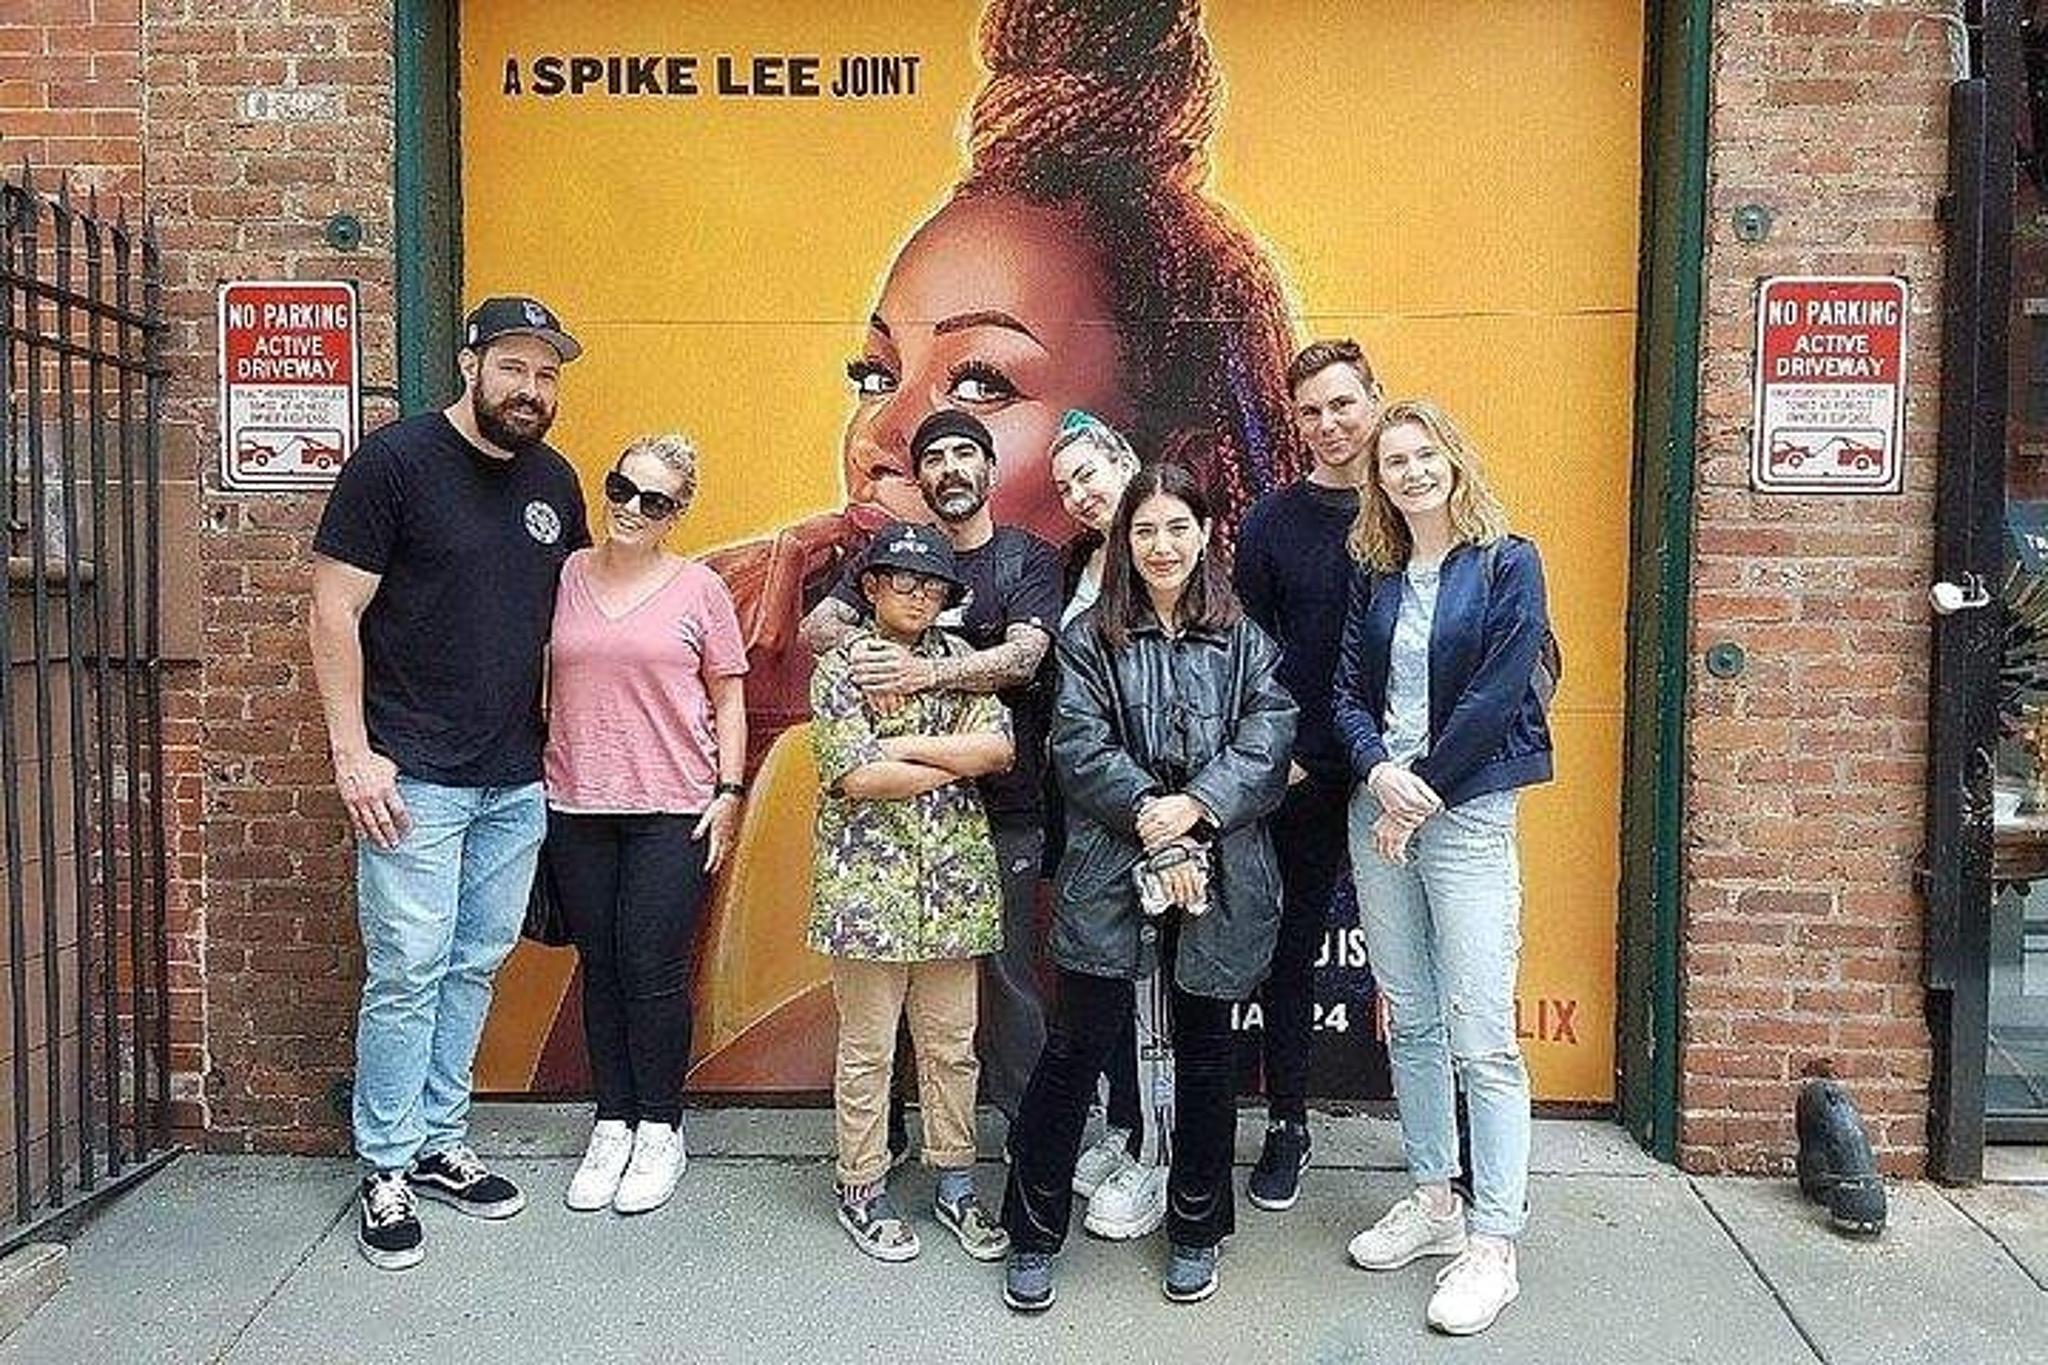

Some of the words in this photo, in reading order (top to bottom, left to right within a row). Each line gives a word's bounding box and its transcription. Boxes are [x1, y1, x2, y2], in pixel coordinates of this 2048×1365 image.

[503, 58, 521, 95] A
[532, 57, 698, 96] SPIKE
[716, 57, 820, 96] LEE
[832, 57, 920, 97] JOINT
[229, 303, 255, 328] NO
[263, 303, 348, 329] PARKING
[1768, 300, 1798, 326] NO
[1807, 300, 1898, 326] PARKING
[254, 335, 324, 356] ACTIVE
[1793, 334, 1870, 354] ACTIVE
[237, 358, 339, 380] DRIVEWAY
[1776, 357, 1886, 377] DRIVEWAY
